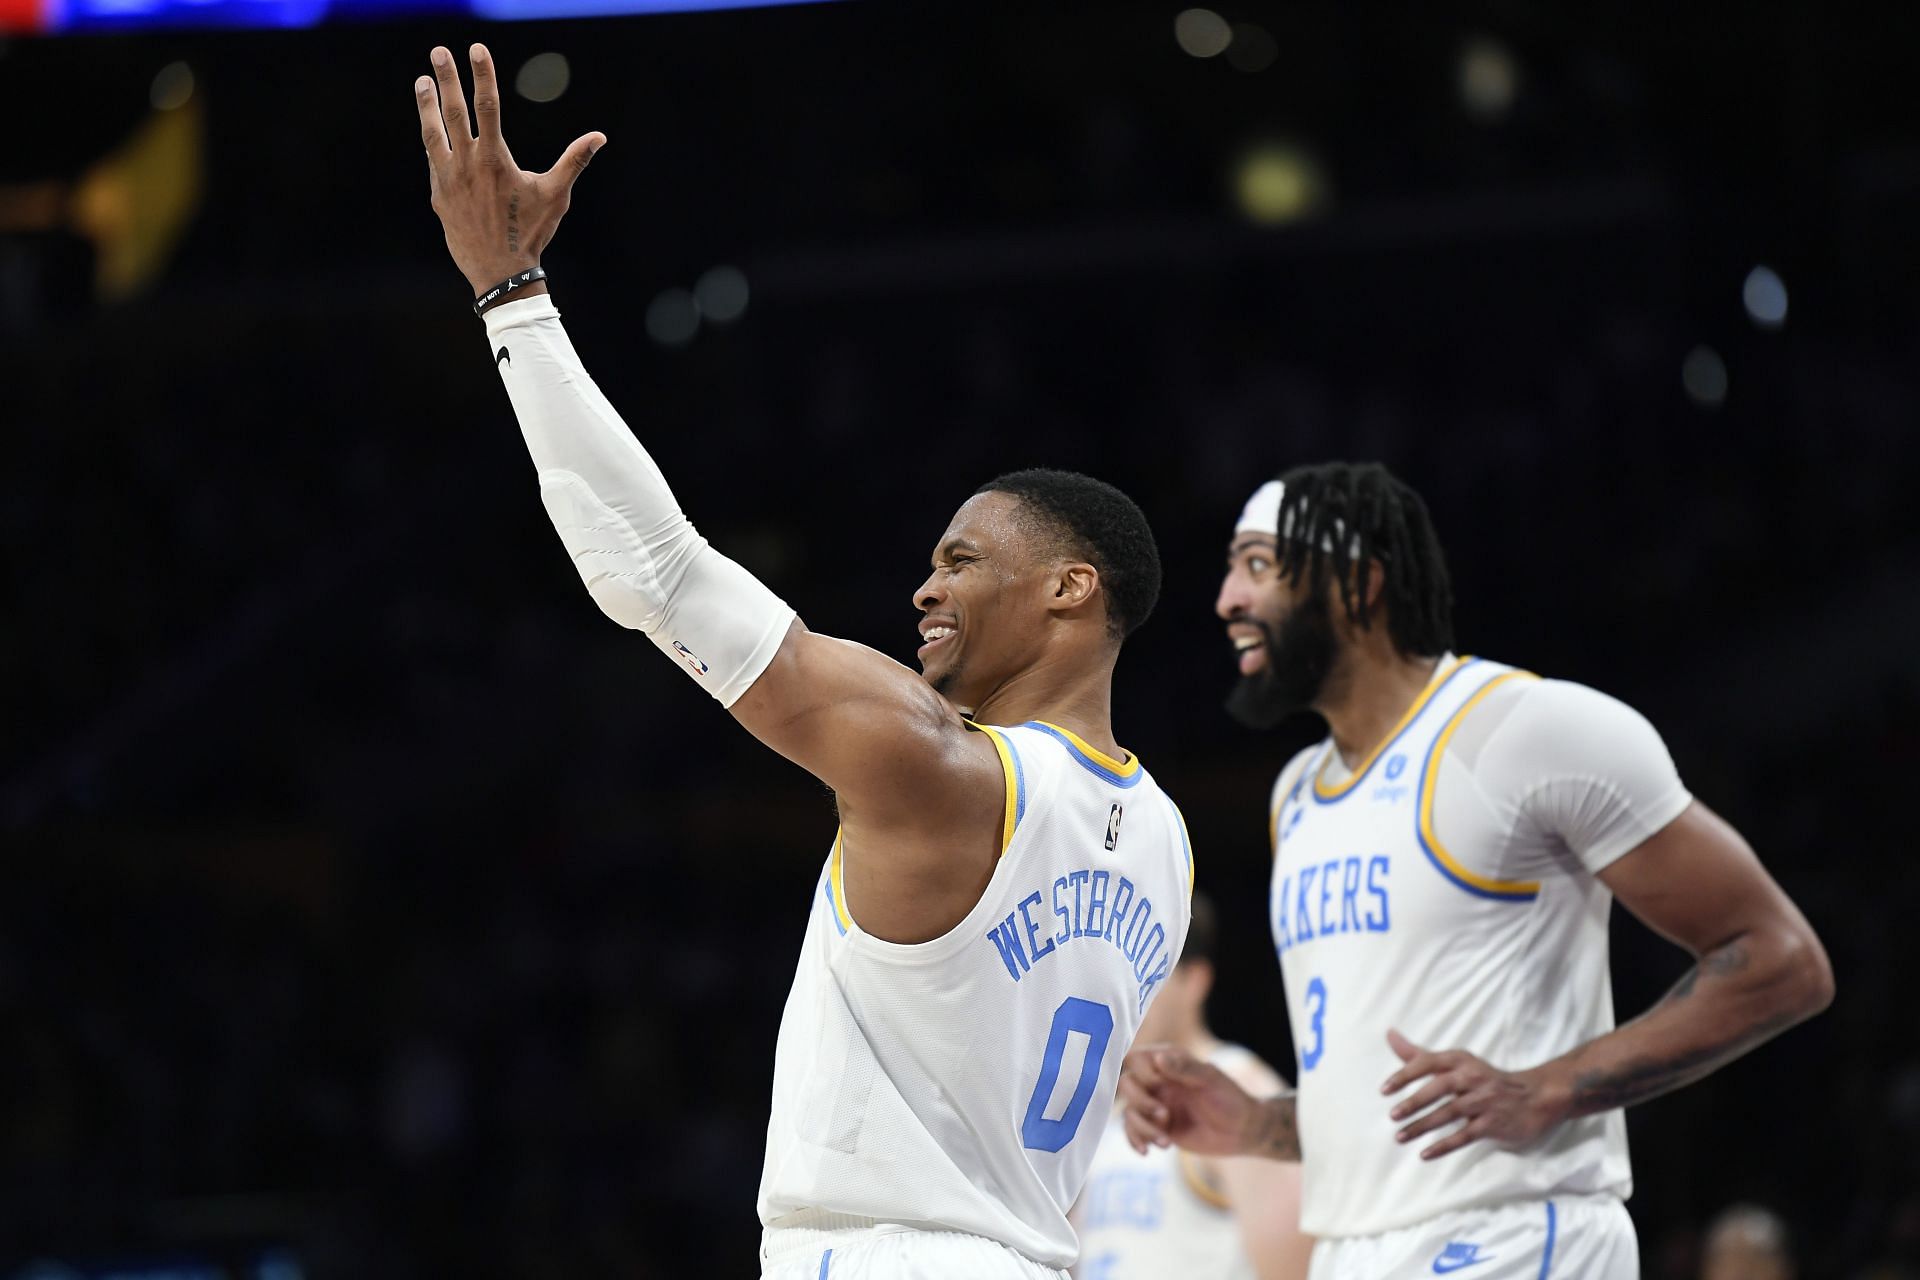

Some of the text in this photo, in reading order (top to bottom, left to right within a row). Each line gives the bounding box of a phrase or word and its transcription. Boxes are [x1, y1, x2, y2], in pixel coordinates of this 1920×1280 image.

[986, 870, 1168, 1015] WESTBROOK
[1277, 855, 1389, 955] AKERS
[1022, 996, 1114, 1153] 0
[1302, 976, 1327, 1072] 3
